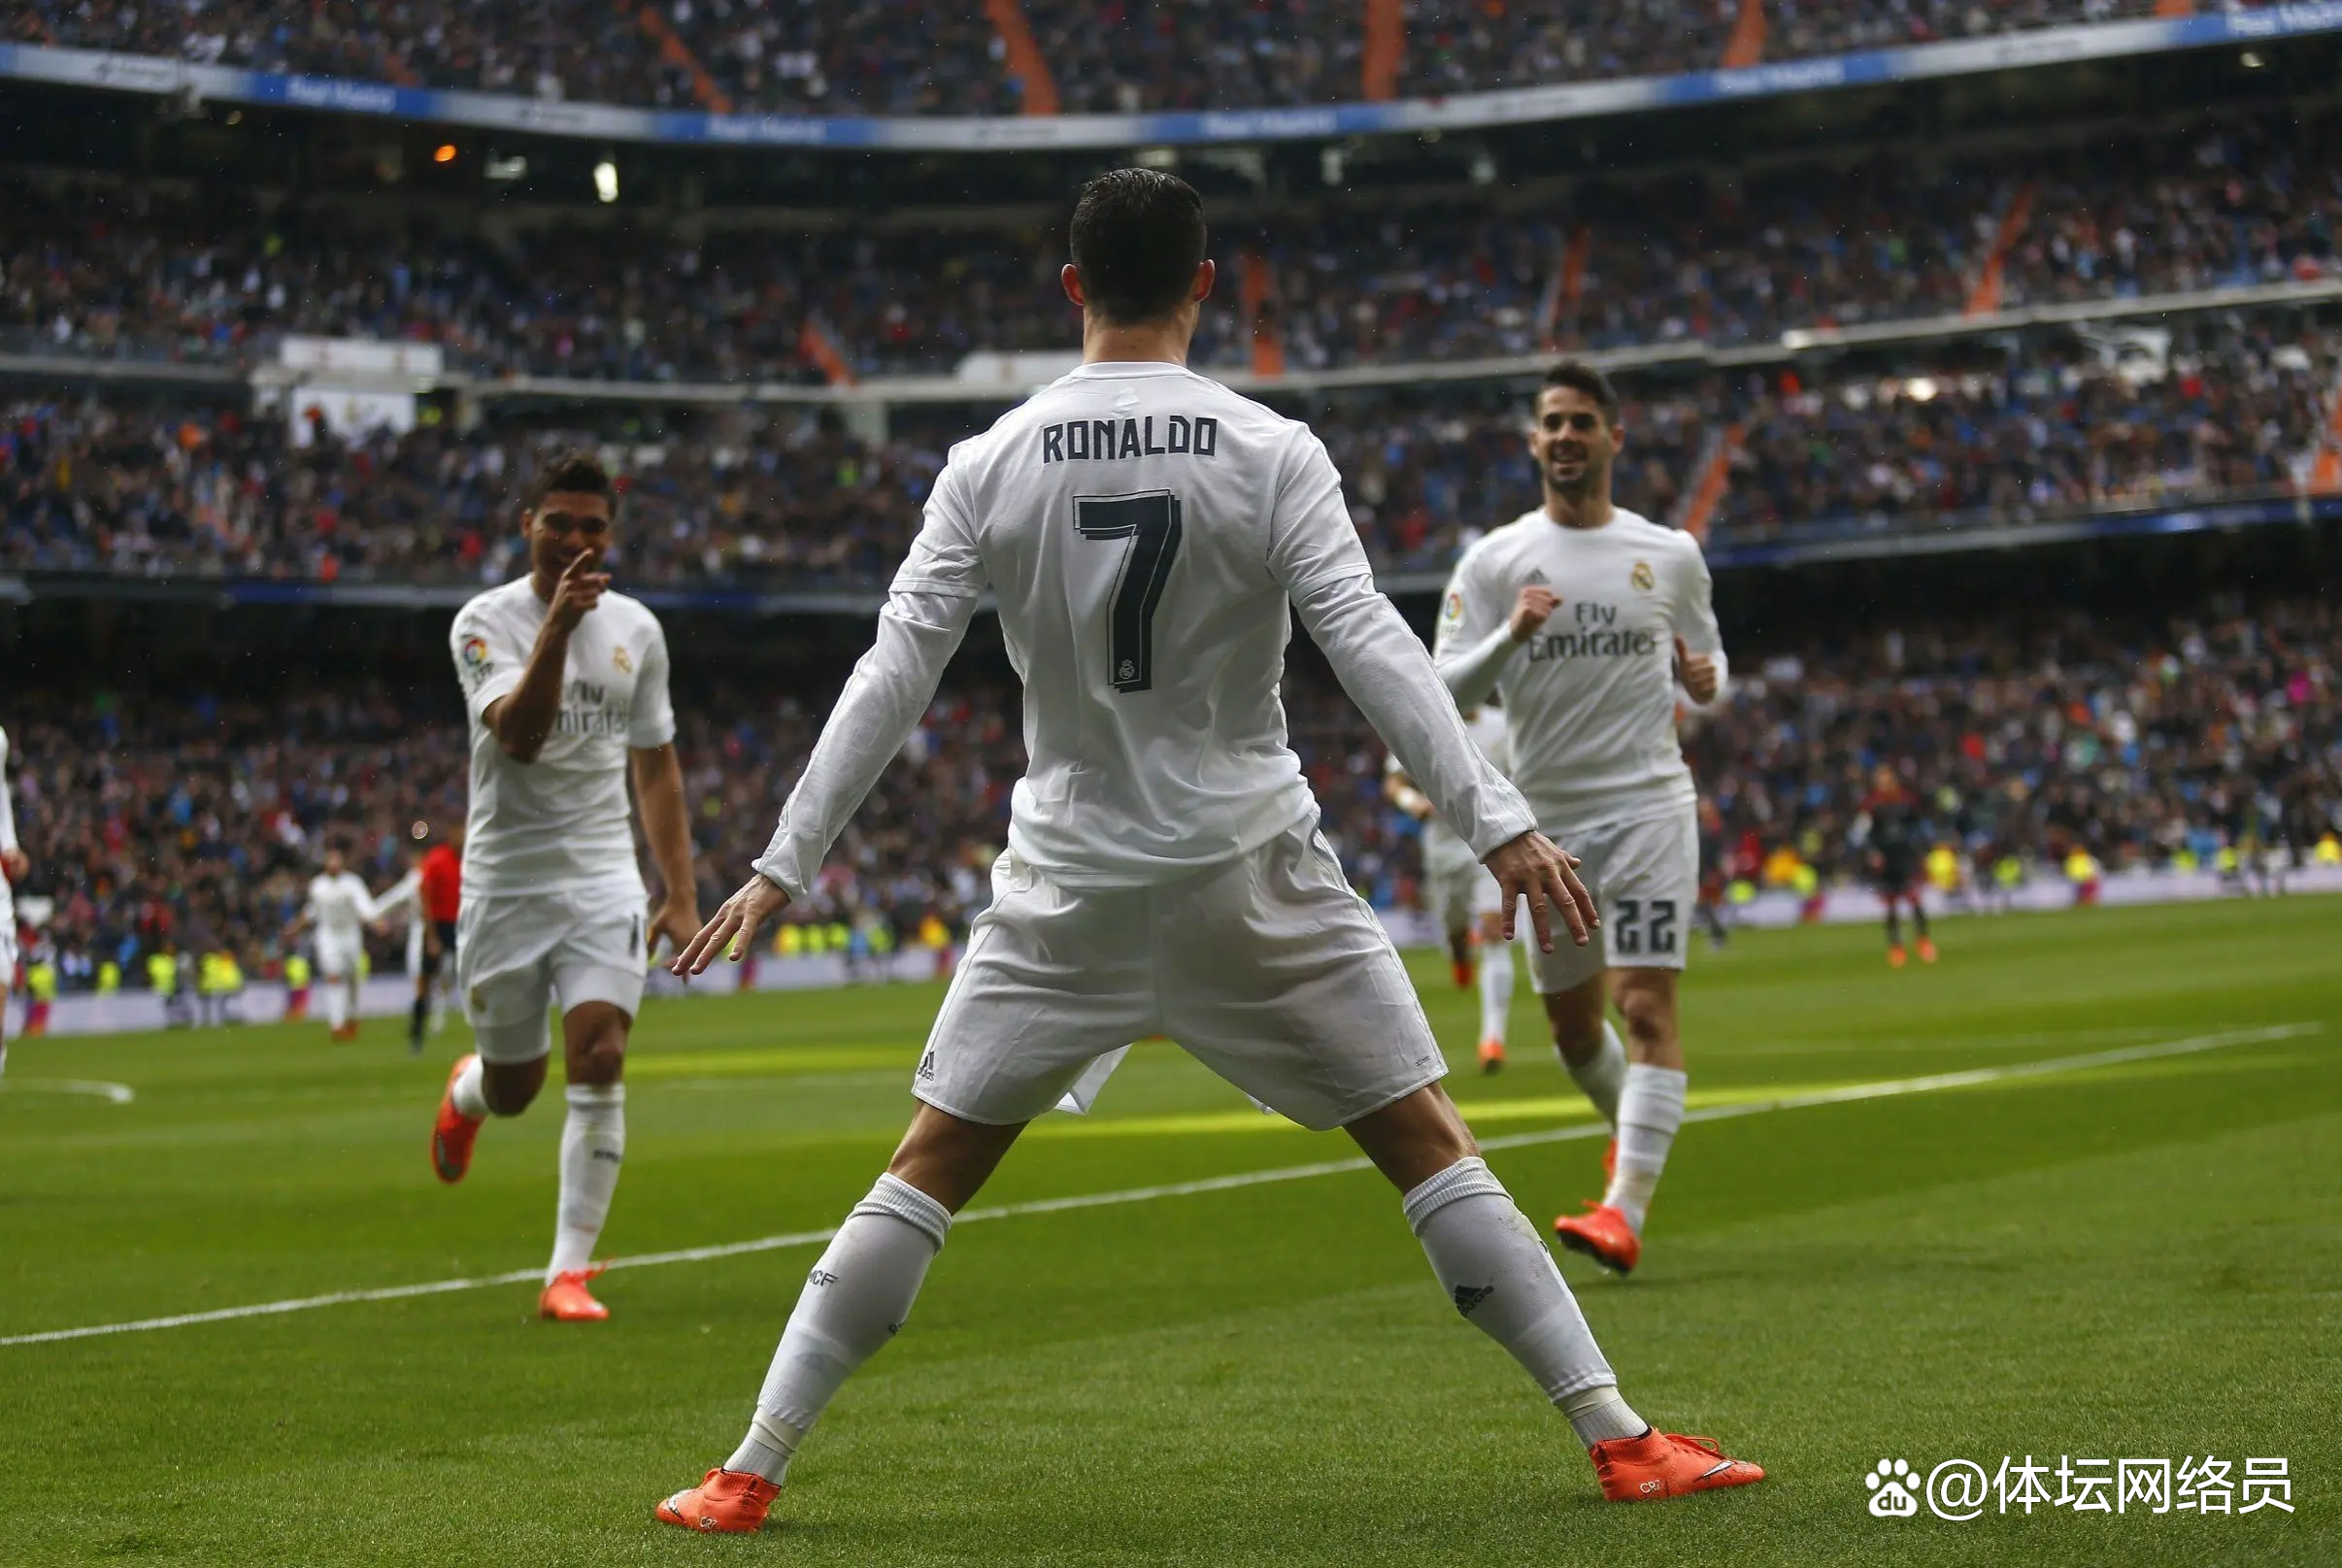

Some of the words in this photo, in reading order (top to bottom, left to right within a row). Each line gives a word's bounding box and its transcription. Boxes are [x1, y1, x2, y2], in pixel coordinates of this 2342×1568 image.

[1043, 415, 1218, 464] RONALDO
[1073, 488, 1182, 693] 7
[1575, 601, 1617, 627] Fly
[1616, 900, 1676, 953] 22
[808, 1269, 839, 1286] MCF
[1639, 1479, 1660, 1493] CR7
[699, 1516, 719, 1530] CR7
